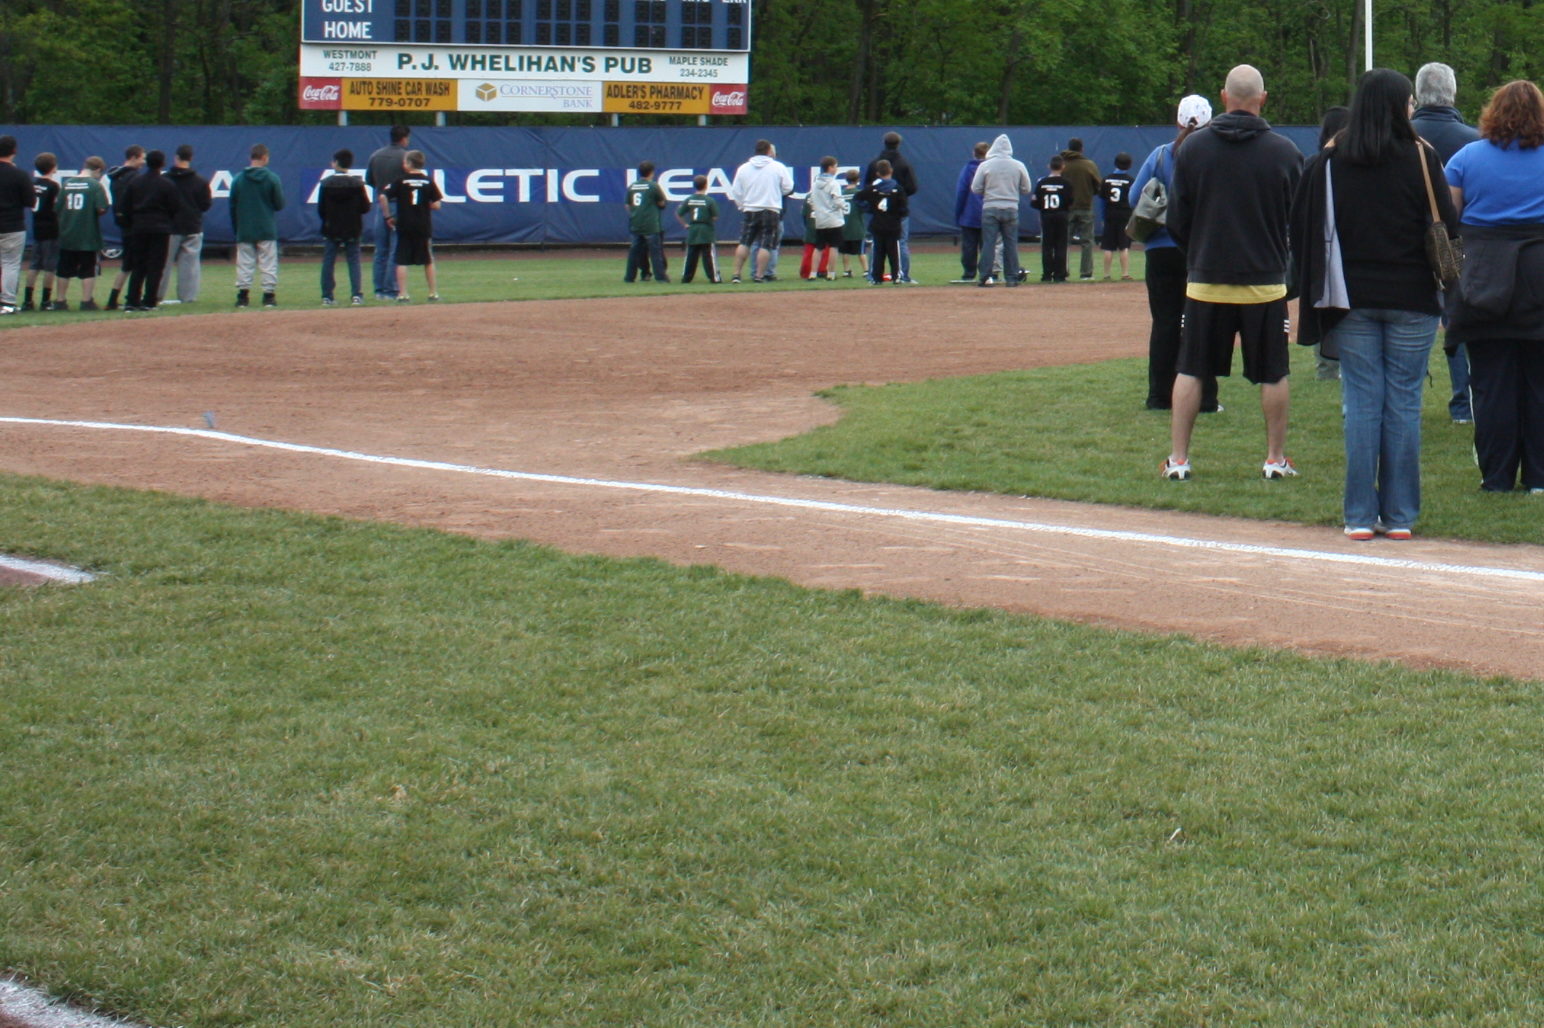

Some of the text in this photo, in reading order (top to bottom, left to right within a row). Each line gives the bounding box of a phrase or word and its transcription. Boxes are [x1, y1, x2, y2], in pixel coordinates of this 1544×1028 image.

[324, 21, 372, 38] HOME
[323, 49, 377, 59] WESTMONT
[669, 56, 728, 66] MAPLE SHADE
[328, 62, 372, 71] 427-7888
[397, 53, 652, 73] P.J. WHELIHAN'S PUB
[680, 68, 718, 78] 234-2345
[302, 84, 340, 102] Coca-Cola
[350, 81, 450, 96] AUTO SHINE CAR WASH
[500, 83, 593, 98] CORNERSTONE
[606, 84, 703, 100] ADLER'S PHARMACY
[369, 97, 430, 107] 779-0707
[563, 99, 592, 108] BANK
[629, 100, 682, 110] 482-9777
[712, 91, 745, 107] Coca-Cola
[66, 193, 84, 210] 10
[411, 189, 419, 205] 1
[632, 192, 642, 206] 6
[1043, 194, 1060, 209] 10
[1110, 188, 1120, 202] 3
[693, 207, 699, 221] 1
